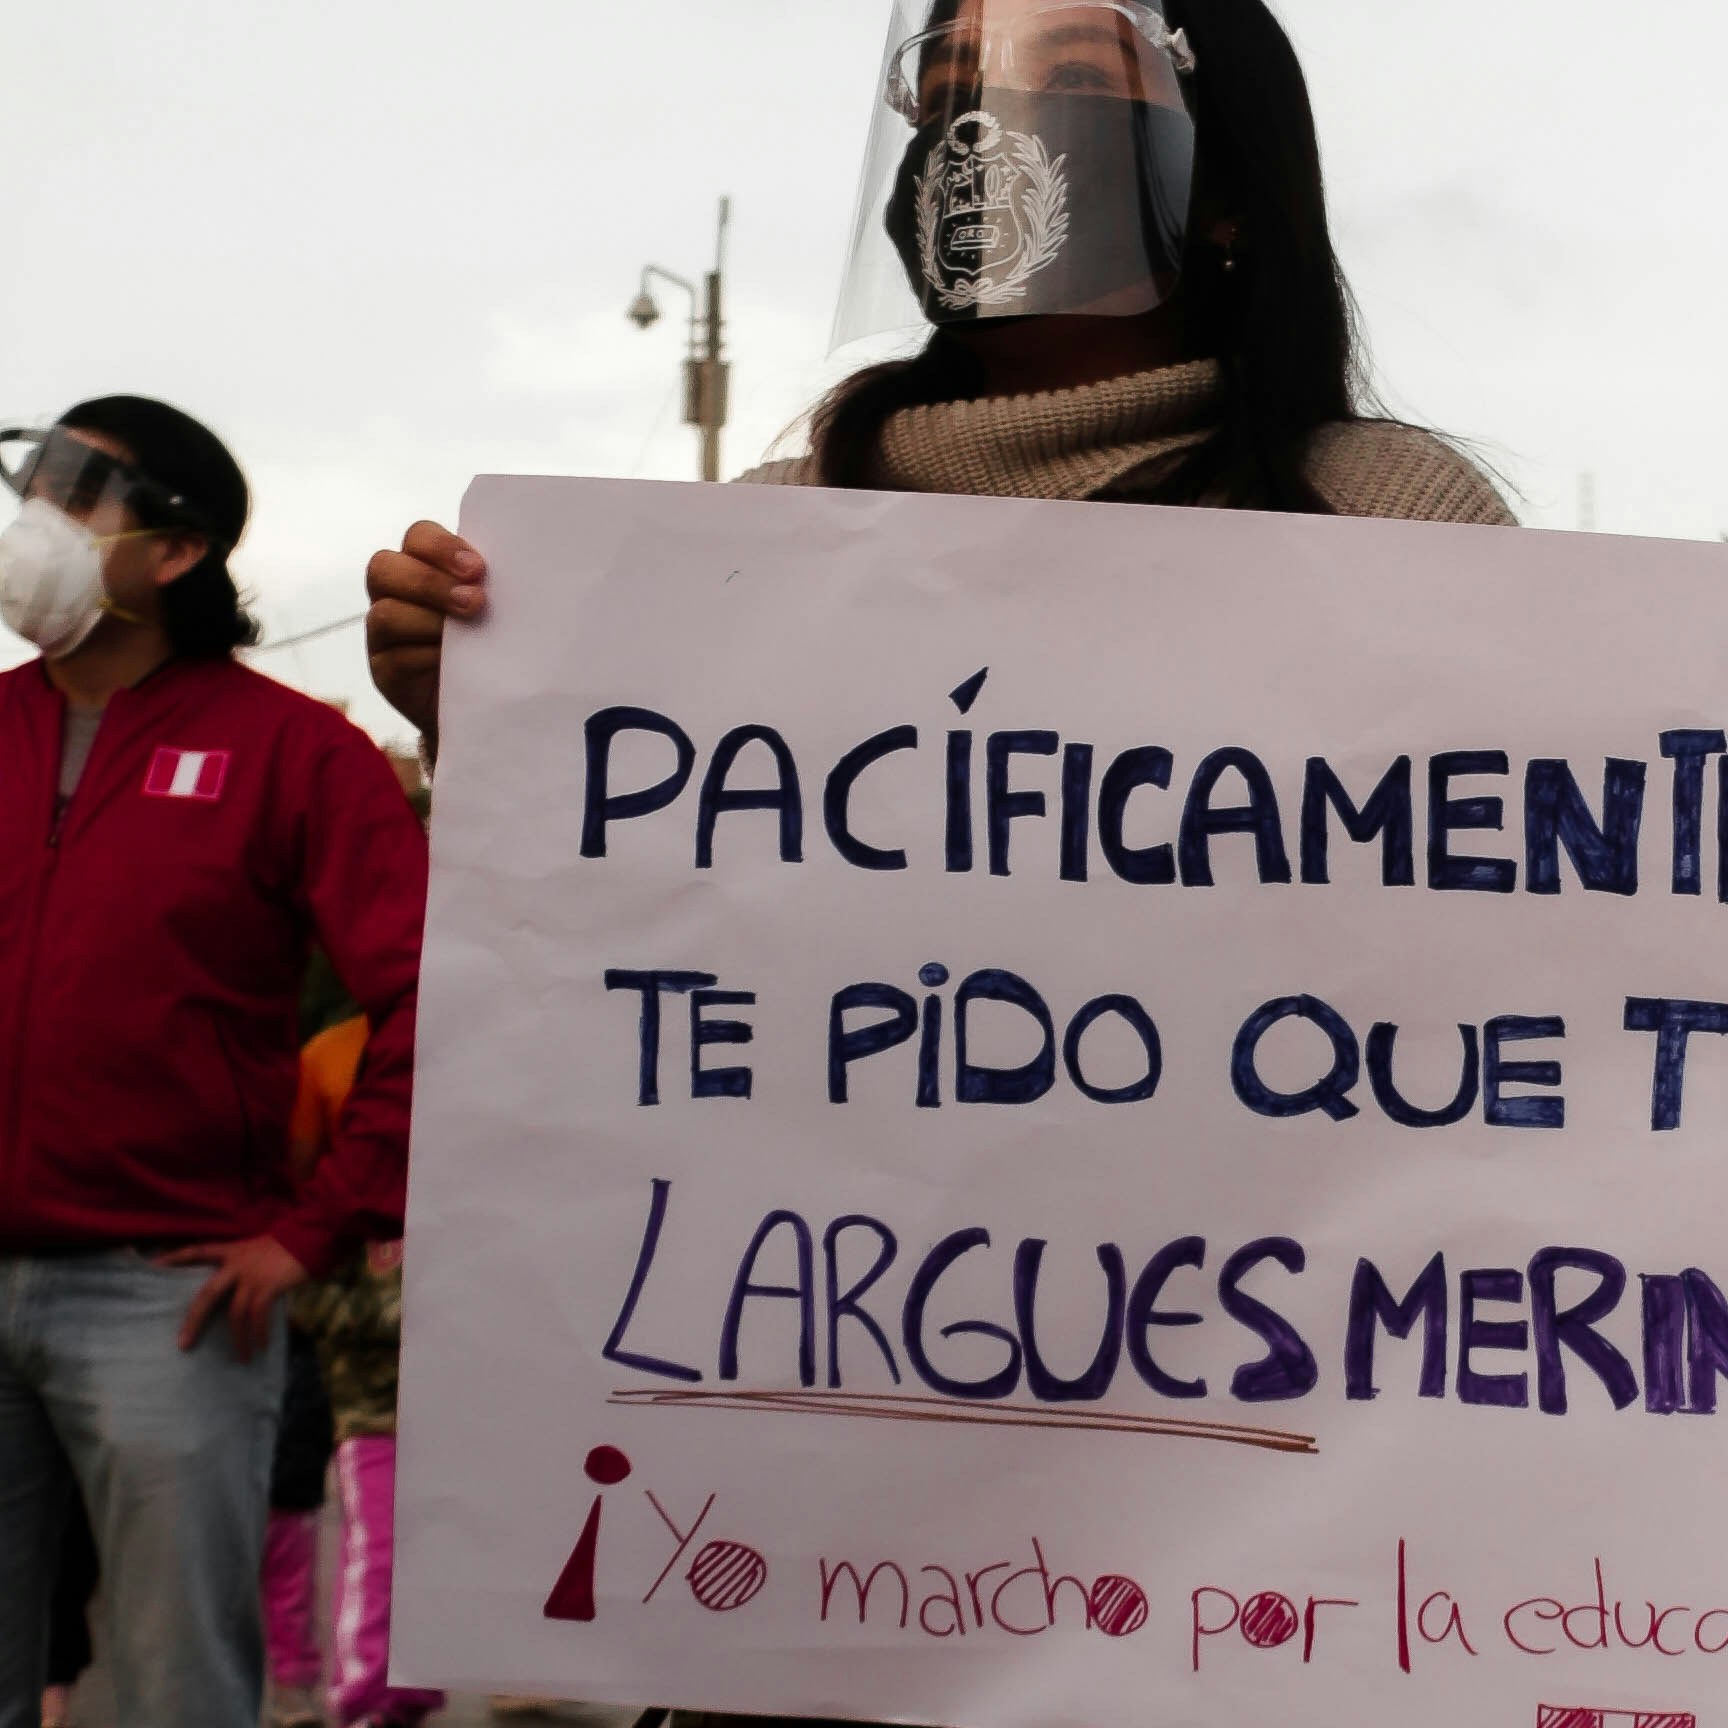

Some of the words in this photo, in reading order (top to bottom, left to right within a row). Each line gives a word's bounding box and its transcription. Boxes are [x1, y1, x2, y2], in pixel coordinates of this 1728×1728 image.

[603, 968, 757, 1107] TE
[1230, 993, 1566, 1129] QUE
[601, 1177, 1319, 1403] LARGUES
[819, 1536, 1150, 1638] marcho
[1191, 1584, 1361, 1672] por
[1397, 1538, 1477, 1674] la
